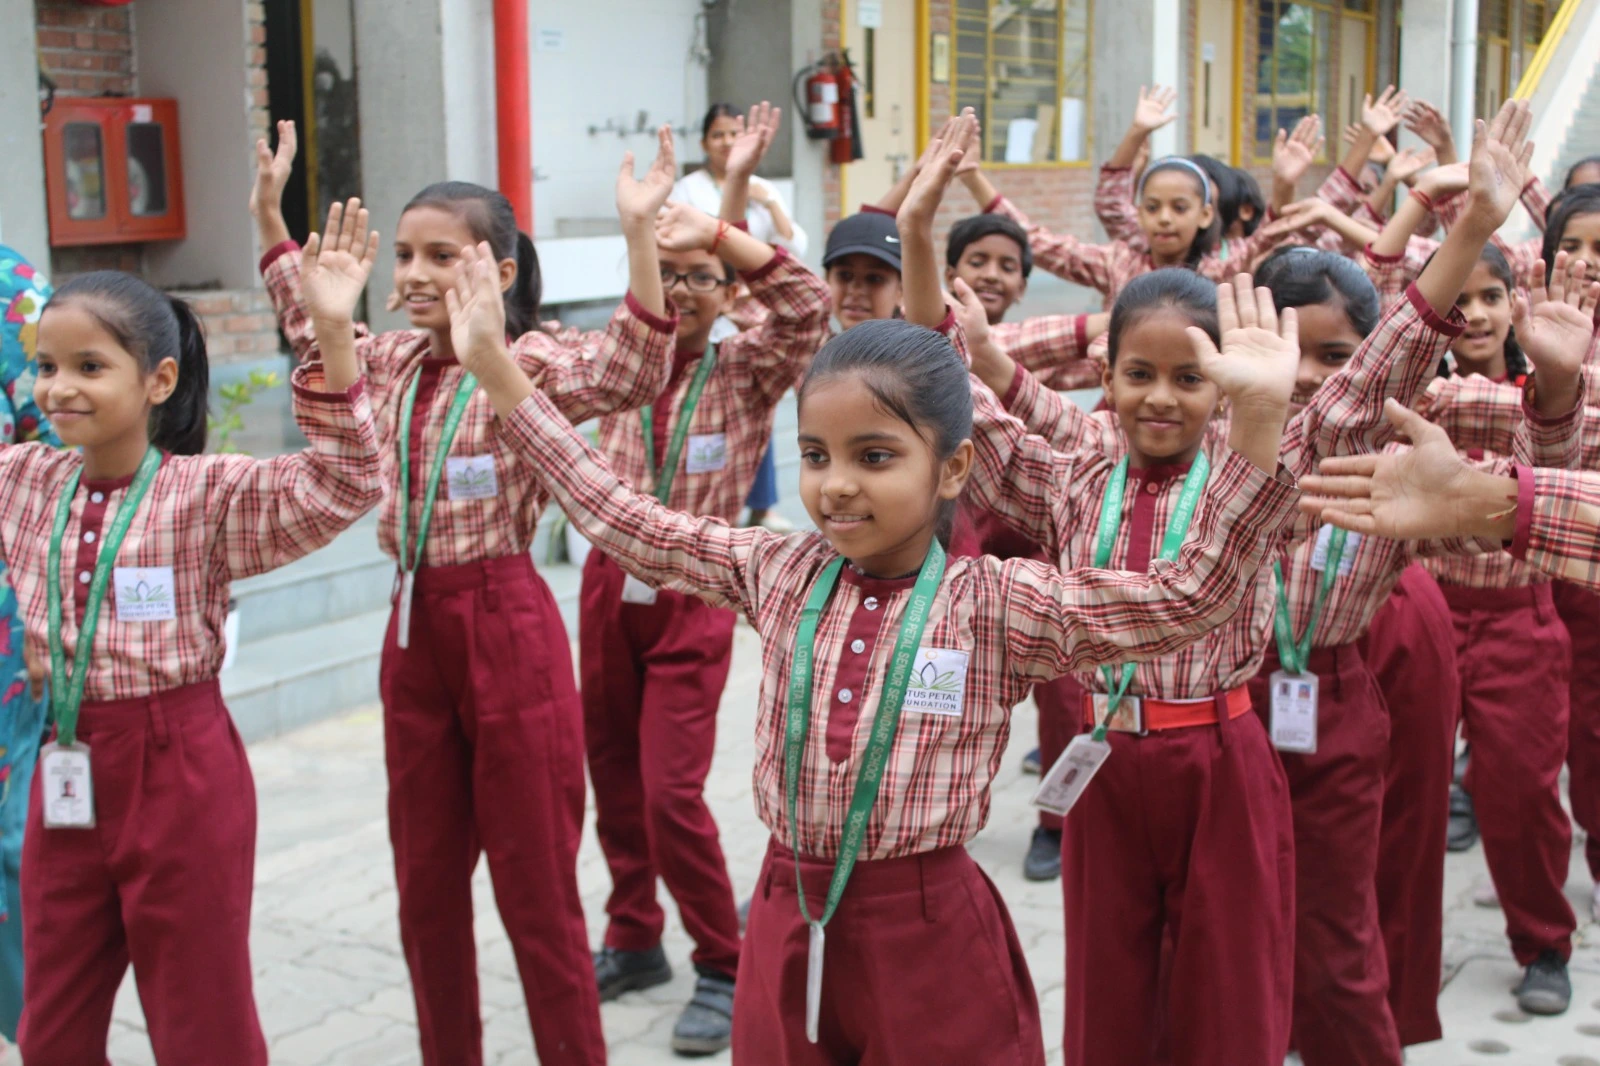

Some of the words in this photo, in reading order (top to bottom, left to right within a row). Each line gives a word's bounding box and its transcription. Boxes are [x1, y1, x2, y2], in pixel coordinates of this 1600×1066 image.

[1171, 510, 1188, 535] LOTUS
[1180, 489, 1196, 511] PETAL
[909, 594, 928, 623] LOTUS
[900, 622, 919, 650] PETAL
[795, 644, 809, 676] LOTUS
[890, 651, 910, 687] SENIOR
[792, 676, 806, 706] PETAL
[903, 699, 957, 710] UNDATION
[905, 689, 926, 699] TUS
[928, 691, 958, 702] PETAL
[791, 707, 804, 743] SENIOR
[875, 687, 900, 746] SECONDARY
[863, 745, 884, 783] SCHOOL
[846, 809, 866, 847] SCHOOL
